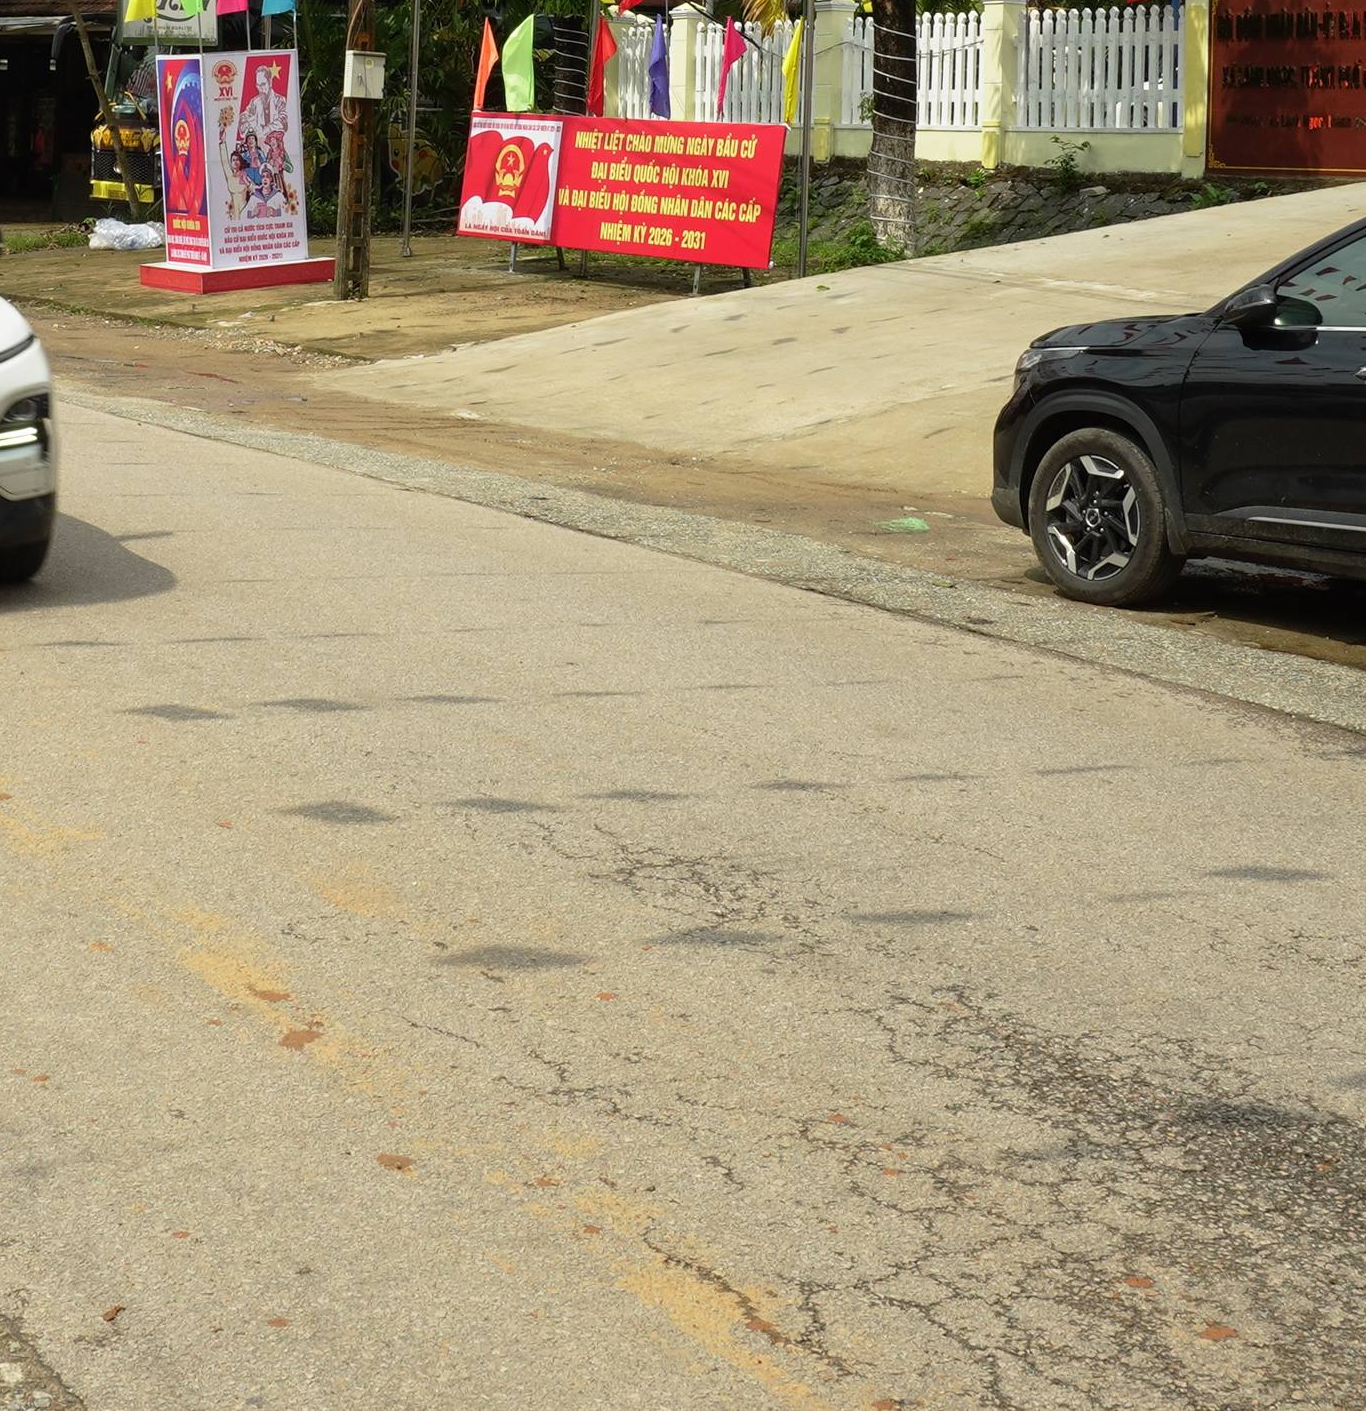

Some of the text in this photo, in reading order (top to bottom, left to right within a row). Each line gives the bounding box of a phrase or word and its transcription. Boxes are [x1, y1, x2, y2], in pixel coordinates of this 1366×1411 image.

[219, 86, 233, 97] XVI
[575, 129, 758, 158] NHIỆT LIỆT CHÀO MỪNG NGÀY BẦU CỬ
[590, 157, 730, 189] ĐẠI BIỂU QUỐC HỘI KHÓA XVI
[558, 185, 762, 223] VÀ ĐẠI BIỂU HỘI ĐỒNG NHÂN DÂN CÁC CẤP
[599, 220, 632, 245] NHIỆM
[632, 222, 647, 242] KỲ
[648, 228, 673, 247] 2026
[681, 230, 706, 250] 2031
